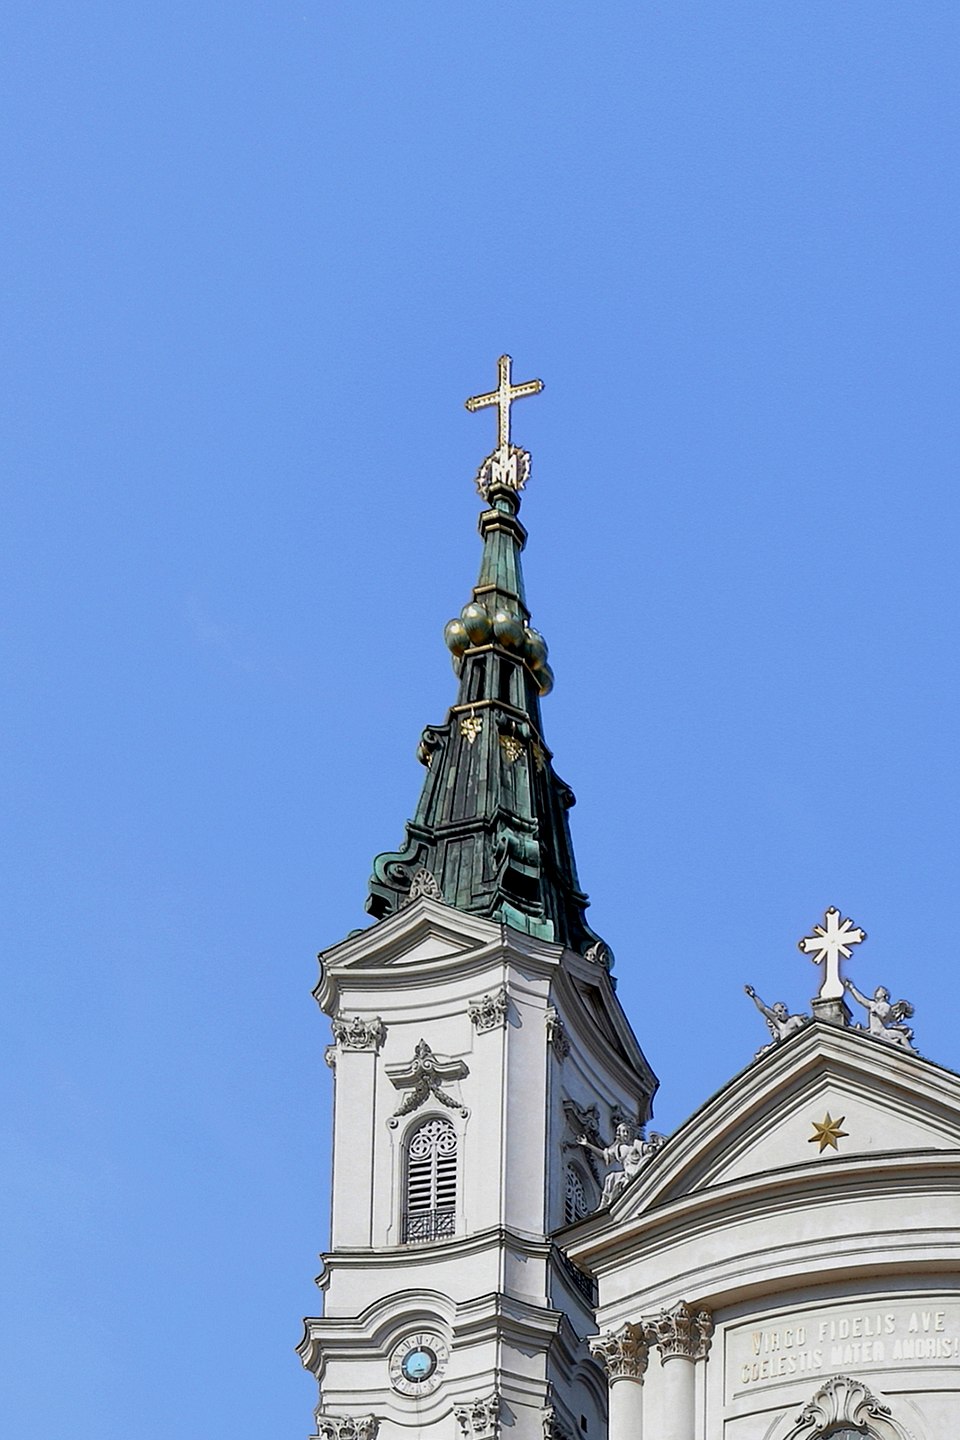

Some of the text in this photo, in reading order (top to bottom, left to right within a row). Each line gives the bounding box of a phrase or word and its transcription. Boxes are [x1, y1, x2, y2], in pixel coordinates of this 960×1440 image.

[751, 1311, 946, 1356] VIRGO FIDELIS AVE
[741, 1336, 960, 1384] COELESTIS MATER AMORIS!
